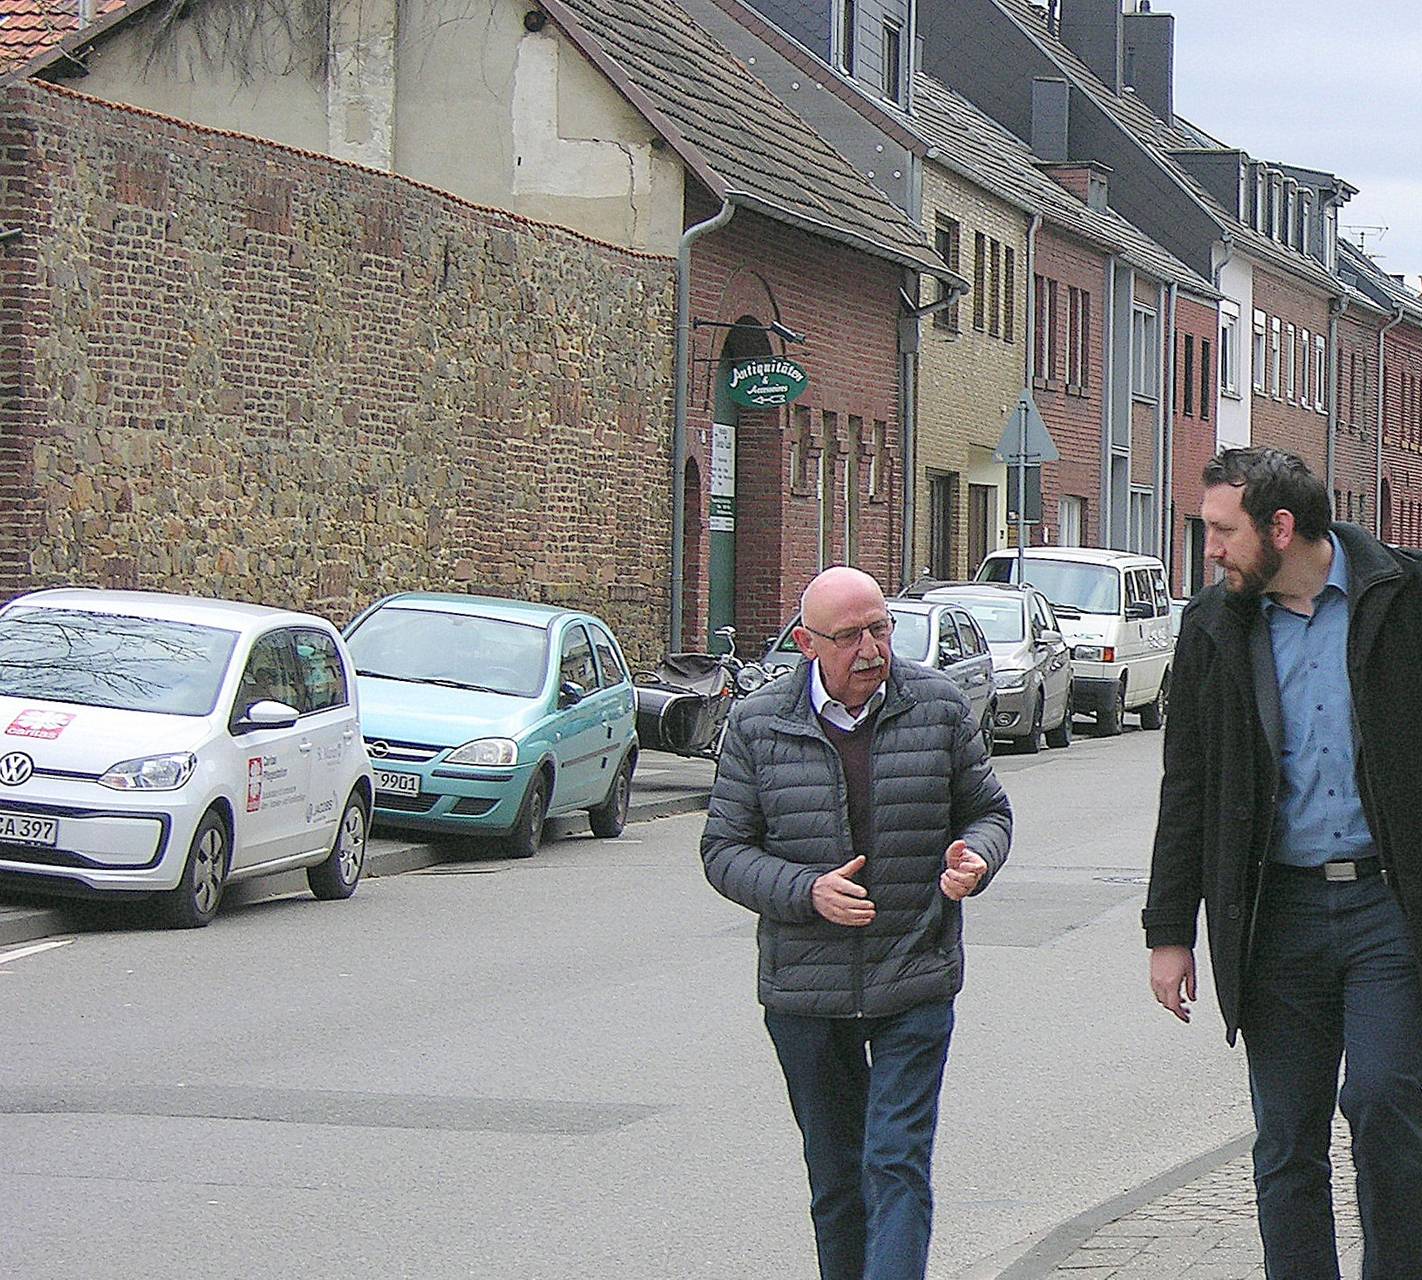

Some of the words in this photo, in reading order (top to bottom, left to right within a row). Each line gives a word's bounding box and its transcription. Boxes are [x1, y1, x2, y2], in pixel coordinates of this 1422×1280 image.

[730, 360, 804, 388] Antiquitäten
[381, 773, 416, 791] 9901
[20, 819, 53, 839] 397
